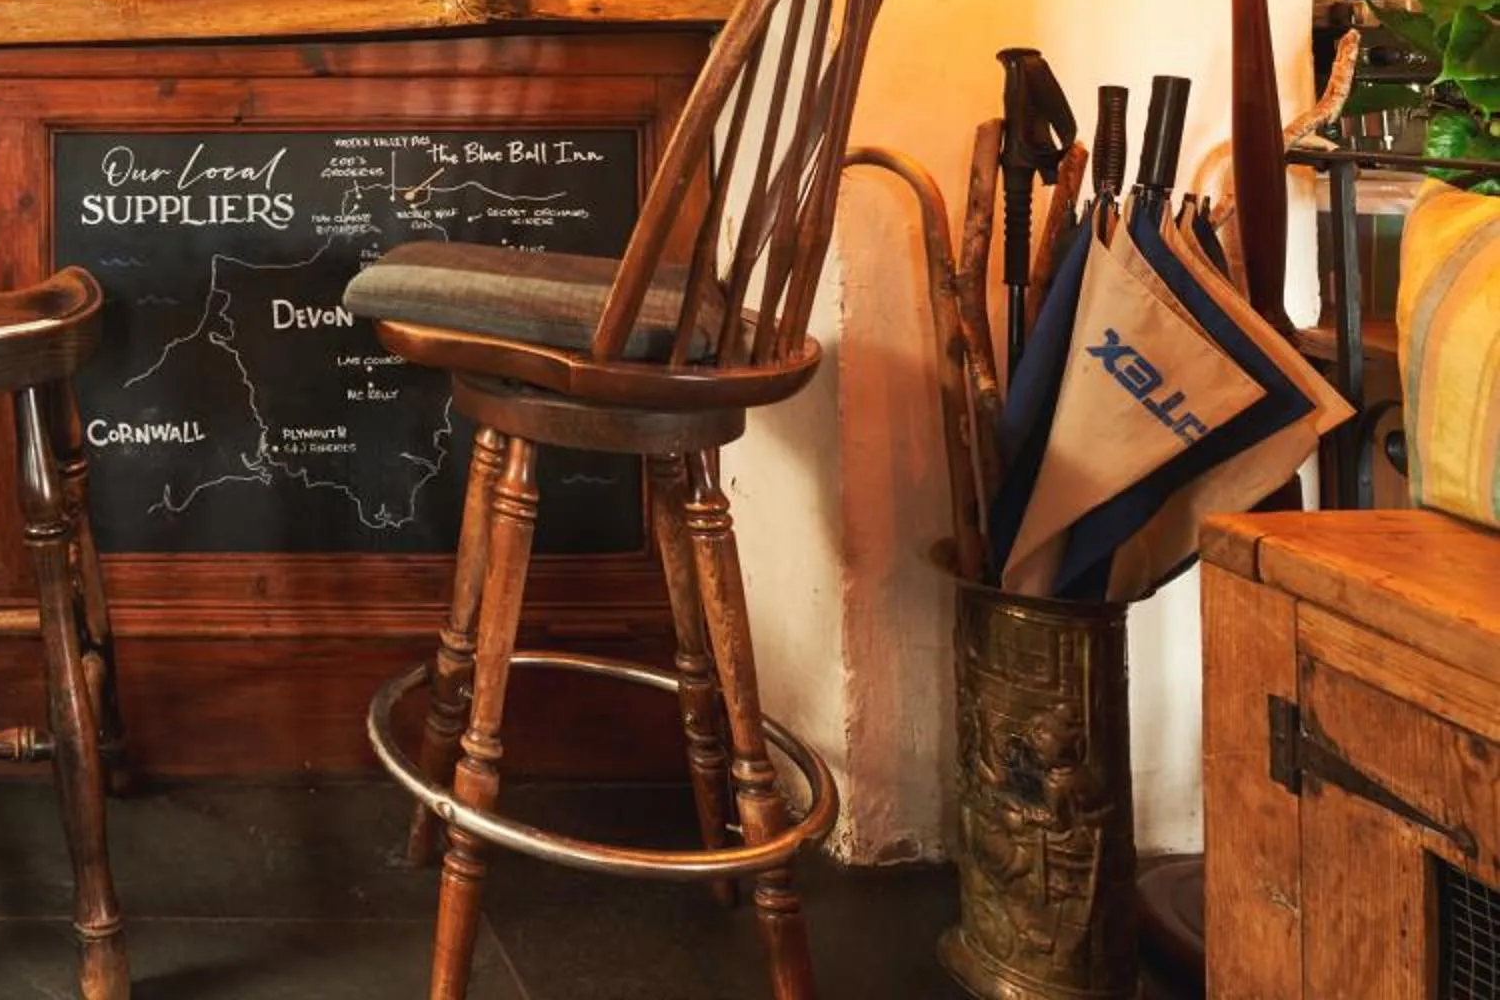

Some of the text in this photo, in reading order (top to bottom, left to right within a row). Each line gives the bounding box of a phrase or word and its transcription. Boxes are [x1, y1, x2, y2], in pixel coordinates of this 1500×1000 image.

[101, 143, 288, 190] Our Local
[463, 143, 503, 164] Blue
[507, 141, 548, 164] Ball
[557, 141, 605, 165] Inn
[80, 193, 295, 229] SUPPLIERS
[271, 299, 355, 331] DEVON
[86, 419, 207, 447] CORNWALL
